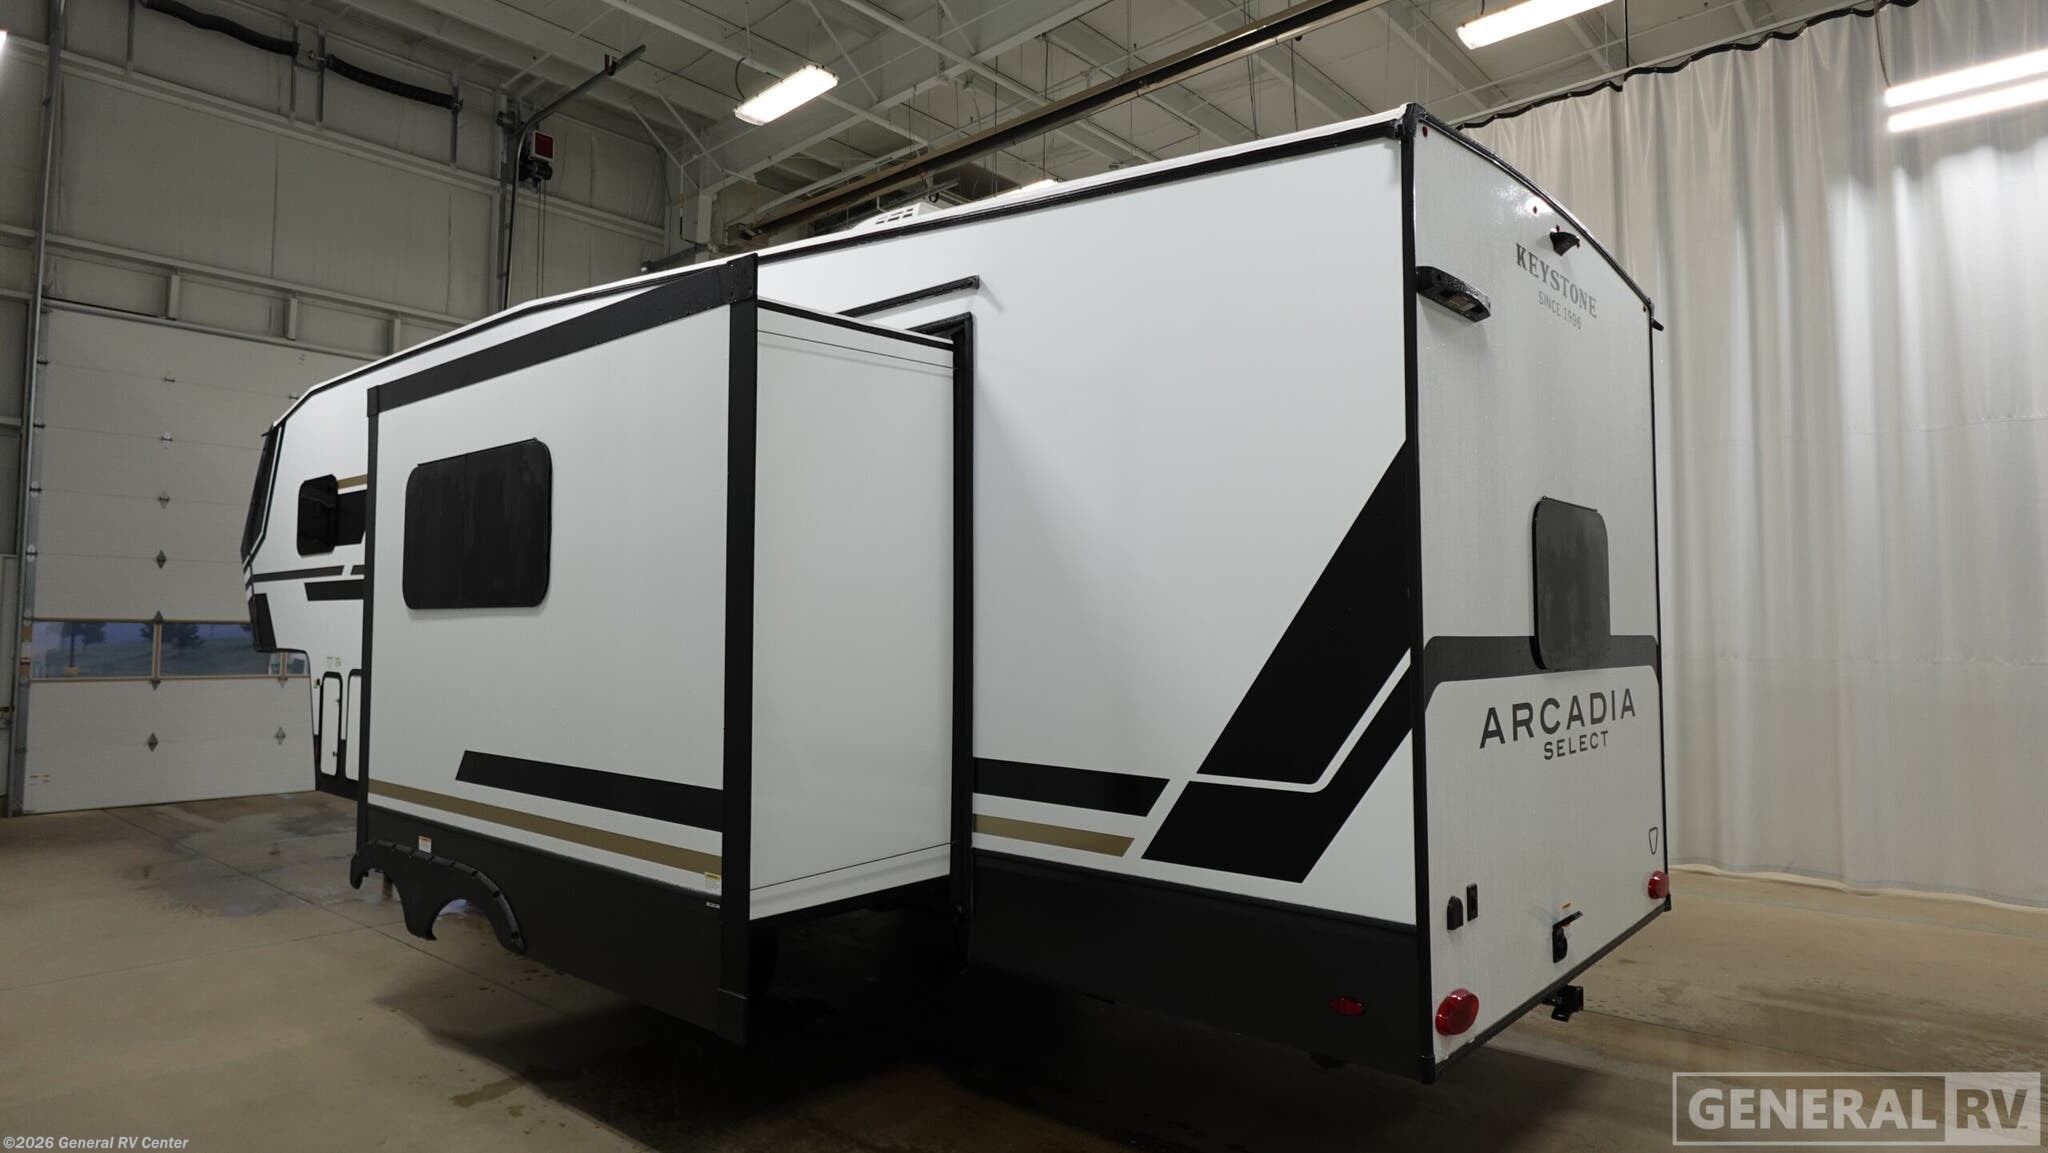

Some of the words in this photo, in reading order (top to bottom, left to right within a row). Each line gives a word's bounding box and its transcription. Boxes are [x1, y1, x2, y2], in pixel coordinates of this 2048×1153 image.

[1515, 242, 1597, 318] KEYSTONE
[1538, 291, 1561, 317] SINCE
[1563, 307, 1582, 330] 1996
[1479, 688, 1636, 749] ARCADIA
[1544, 730, 1609, 760] SELECT
